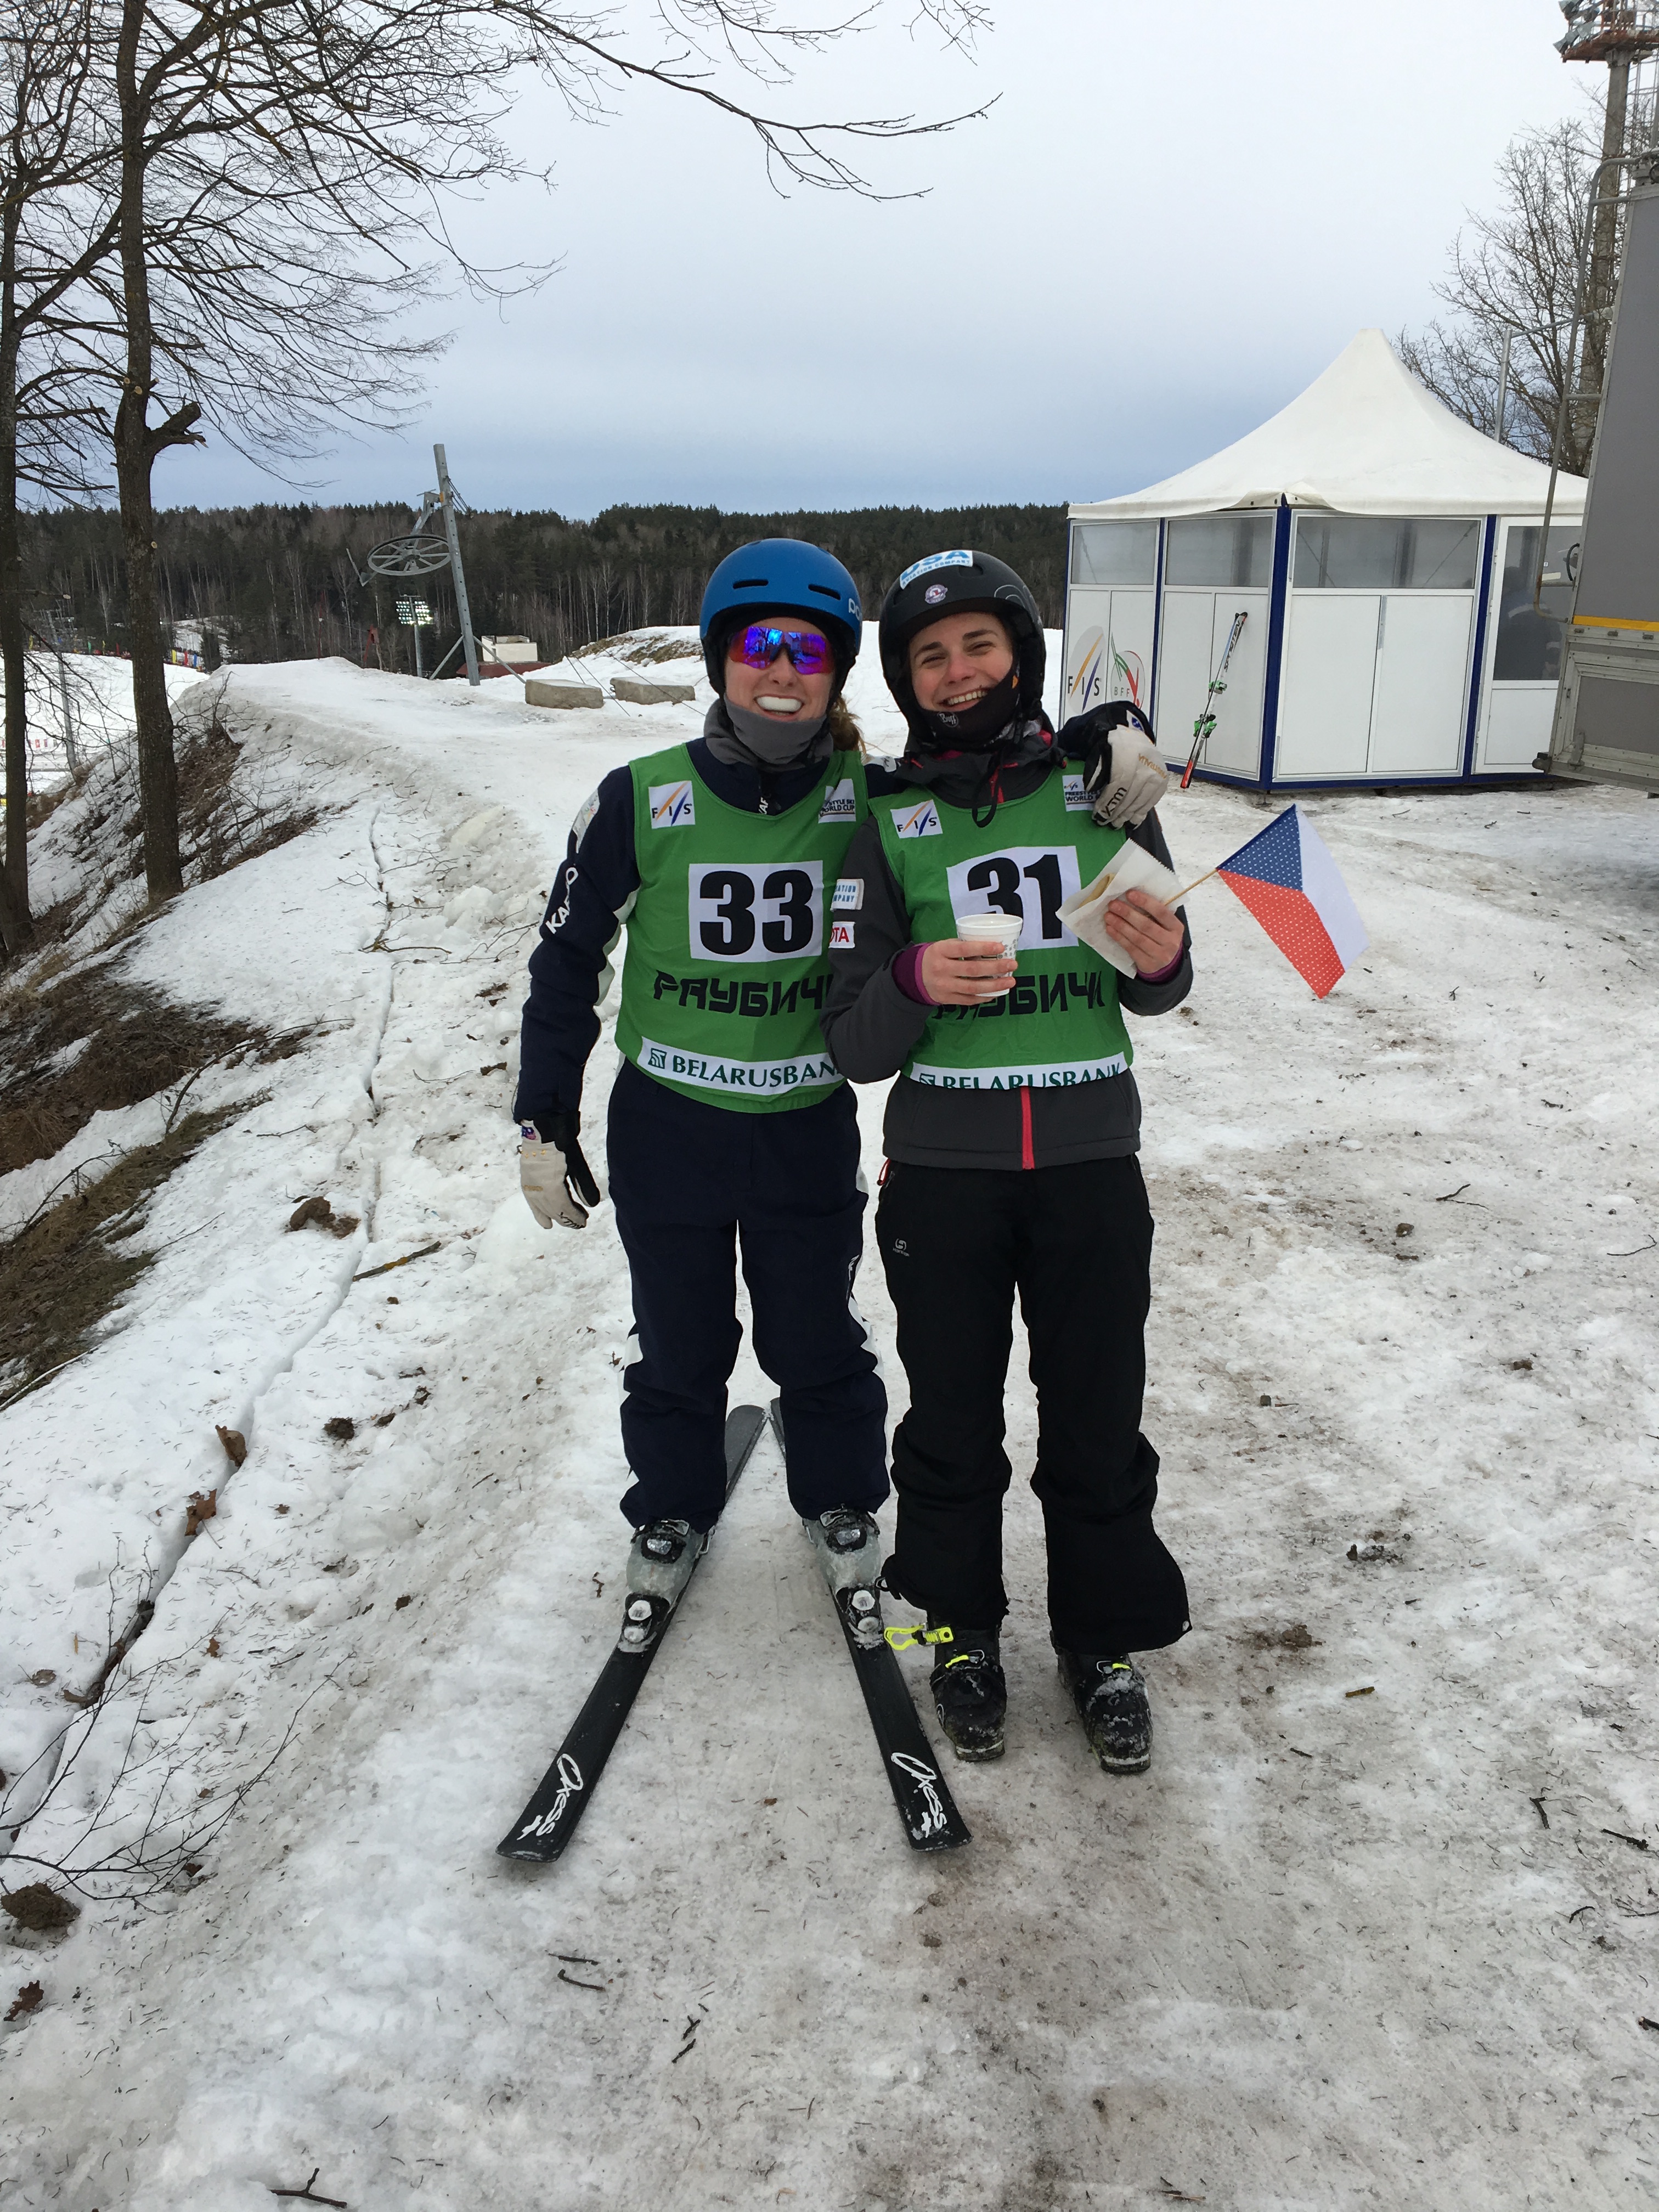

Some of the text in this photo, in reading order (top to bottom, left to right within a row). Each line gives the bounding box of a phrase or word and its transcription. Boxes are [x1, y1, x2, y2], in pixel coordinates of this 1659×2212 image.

[902, 559, 970, 585] AVIATION COMPANY
[1068, 676, 1099, 696] FIS
[1114, 686, 1130, 697] BFF
[652, 803, 692, 819] FIS
[896, 816, 937, 832] FIS
[967, 854, 1063, 940] 31
[699, 869, 814, 956] 33
[673, 1055, 839, 1087] BELARUSBAN
